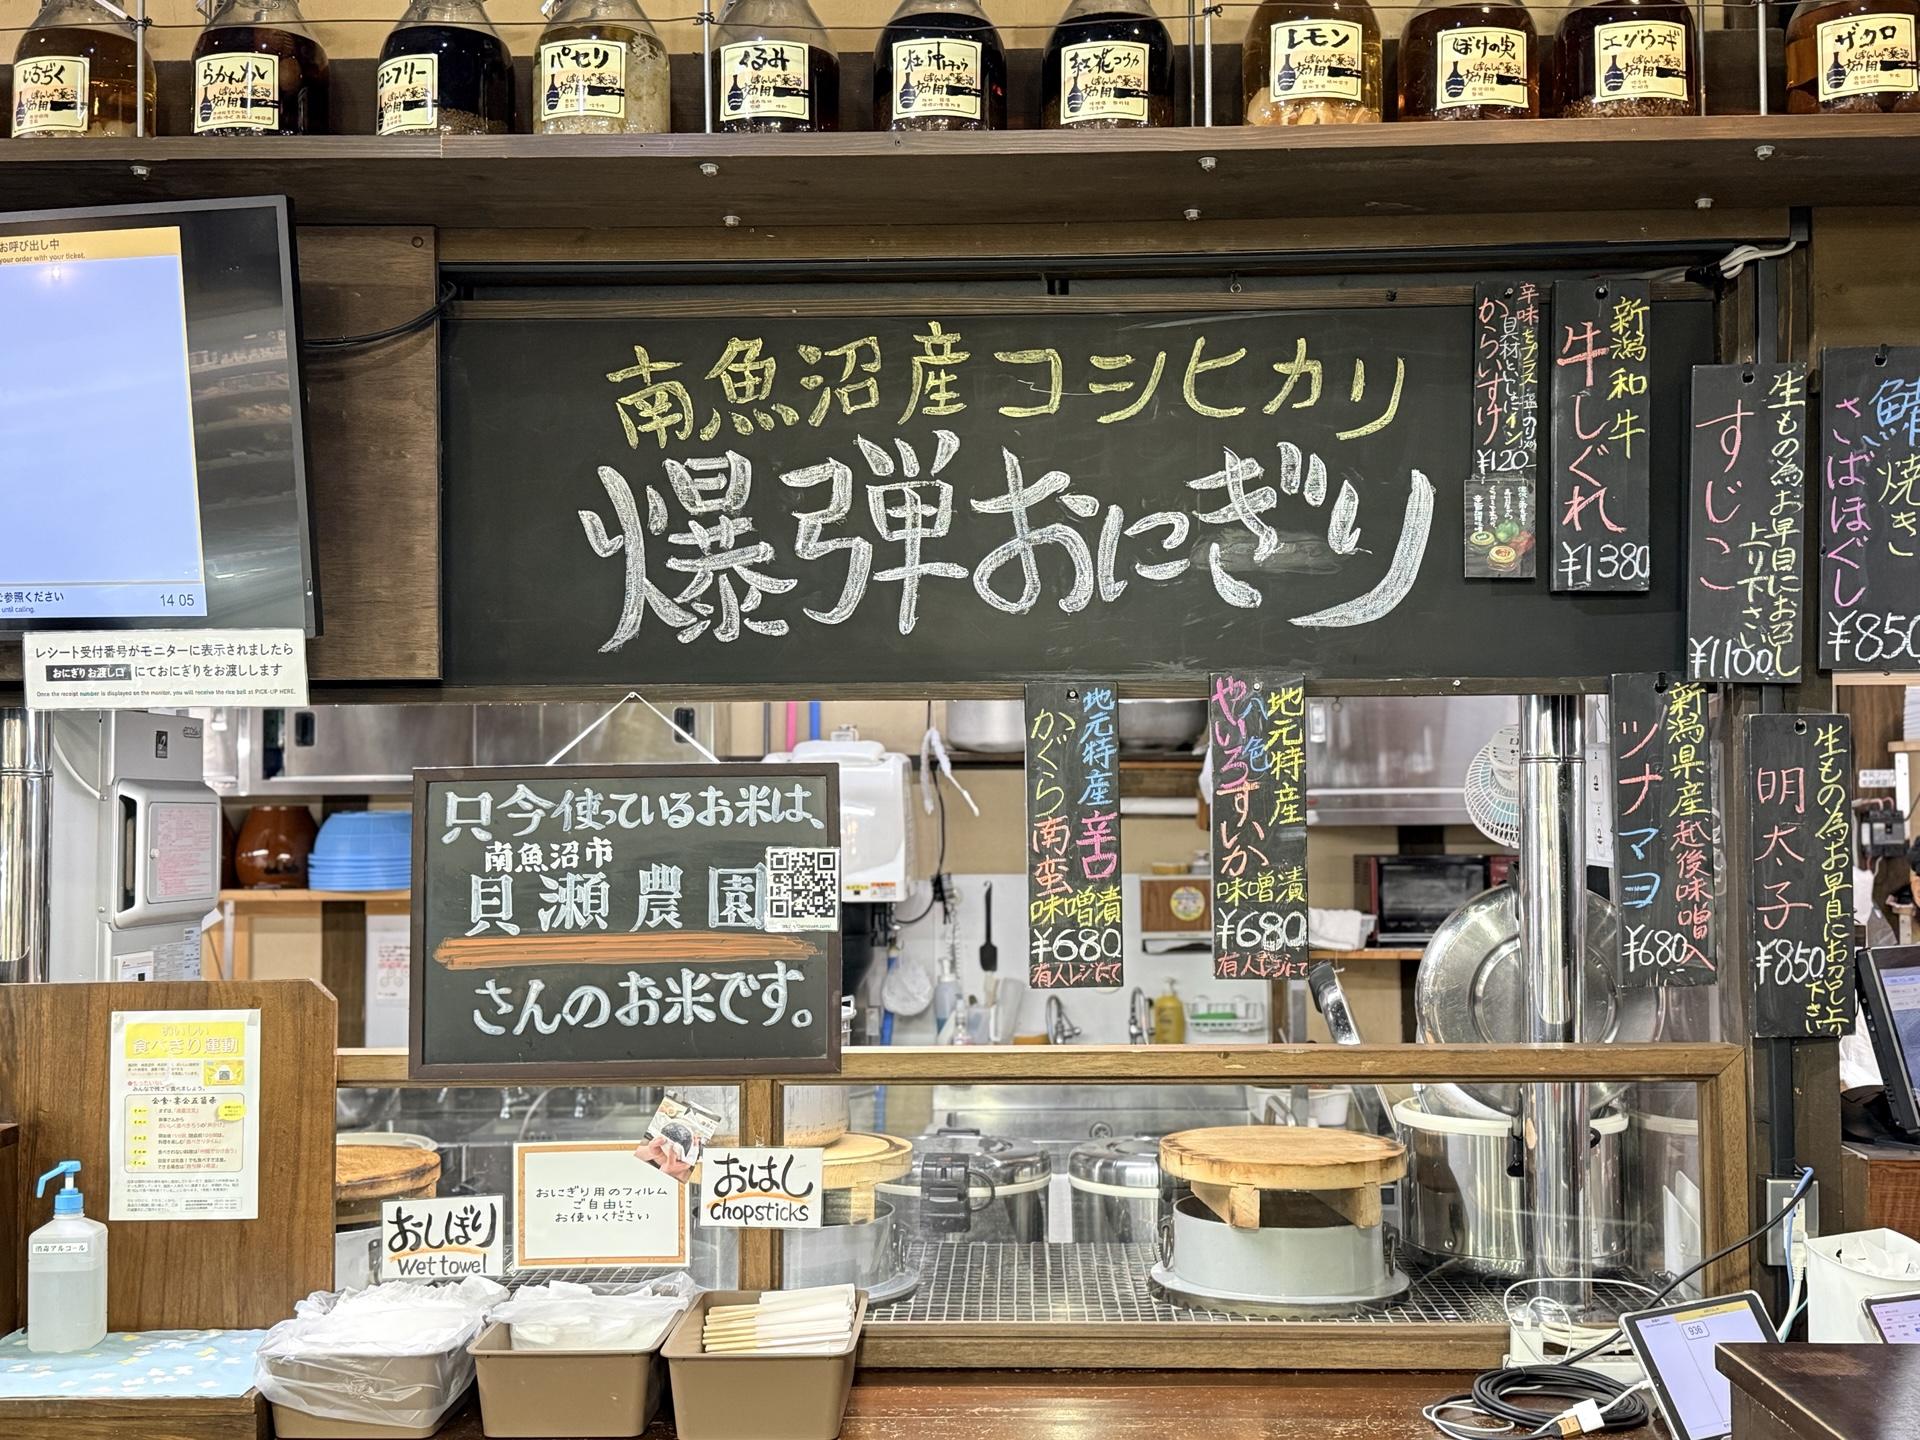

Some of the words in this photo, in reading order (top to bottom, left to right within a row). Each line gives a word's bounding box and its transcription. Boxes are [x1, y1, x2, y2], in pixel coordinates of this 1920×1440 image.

[550, 46, 609, 69] パセリ
[1287, 28, 1349, 49] レモン
[1453, 34, 1516, 60] ぼけの実
[1602, 29, 1680, 51] エゾウコギ
[1835, 23, 1897, 51] ザクロ
[739, 47, 790, 71] くるみ
[0, 238, 59, 252] お呼び出し中
[606, 321, 1405, 449] 南魚沼産コシヒカリ
[1477, 297, 1508, 446] からいすけ
[1607, 296, 1650, 460] 新潟和牛
[1556, 321, 1628, 533] 牛しぐれ
[1696, 399, 1755, 591] すじこ
[1827, 397, 1876, 608] さばほぐし
[578, 430, 1436, 653] 爆弾おにぎり
[35, 643, 294, 659] レシート受付番号がモニターに表示されましたら
[52, 667, 86, 679] おにぎり
[134, 663, 283, 678] にておにぎりをお渡しします
[107, 690, 132, 698] displayed
[195, 689, 214, 697] receive
[216, 688, 224, 696] the
[225, 688, 235, 696] rice
[1241, 698, 1273, 772] 八色
[1211, 676, 1270, 877] やいろすいか
[1264, 687, 1306, 827] 地元特産
[441, 784, 825, 844] 只今使っているお米は、
[1031, 708, 1077, 896] かぐら南蛮
[1618, 721, 1664, 909] ツナマヨ
[484, 836, 614, 873] 南魚沼市
[1754, 767, 1813, 931] 明太子
[464, 863, 767, 937] 貝瀬農園
[1030, 885, 1123, 928] 味噌漬
[1217, 866, 1309, 906] 味噌漬
[1031, 926, 1122, 963] ¥680
[1216, 907, 1308, 951] ¥680
[473, 960, 814, 1036] さんのお米です。
[134, 1037, 240, 1056] 食べきり運動
[536, 1185, 668, 1198] おにぎり用のフィルム
[714, 1153, 814, 1199] おはし
[554, 1210, 650, 1222] お使いください
[573, 1198, 633, 1210] ご自由に
[388, 1203, 498, 1252] おしぼり
[440, 1253, 487, 1276] towel
[1687, 1325, 1704, 1336] 936
